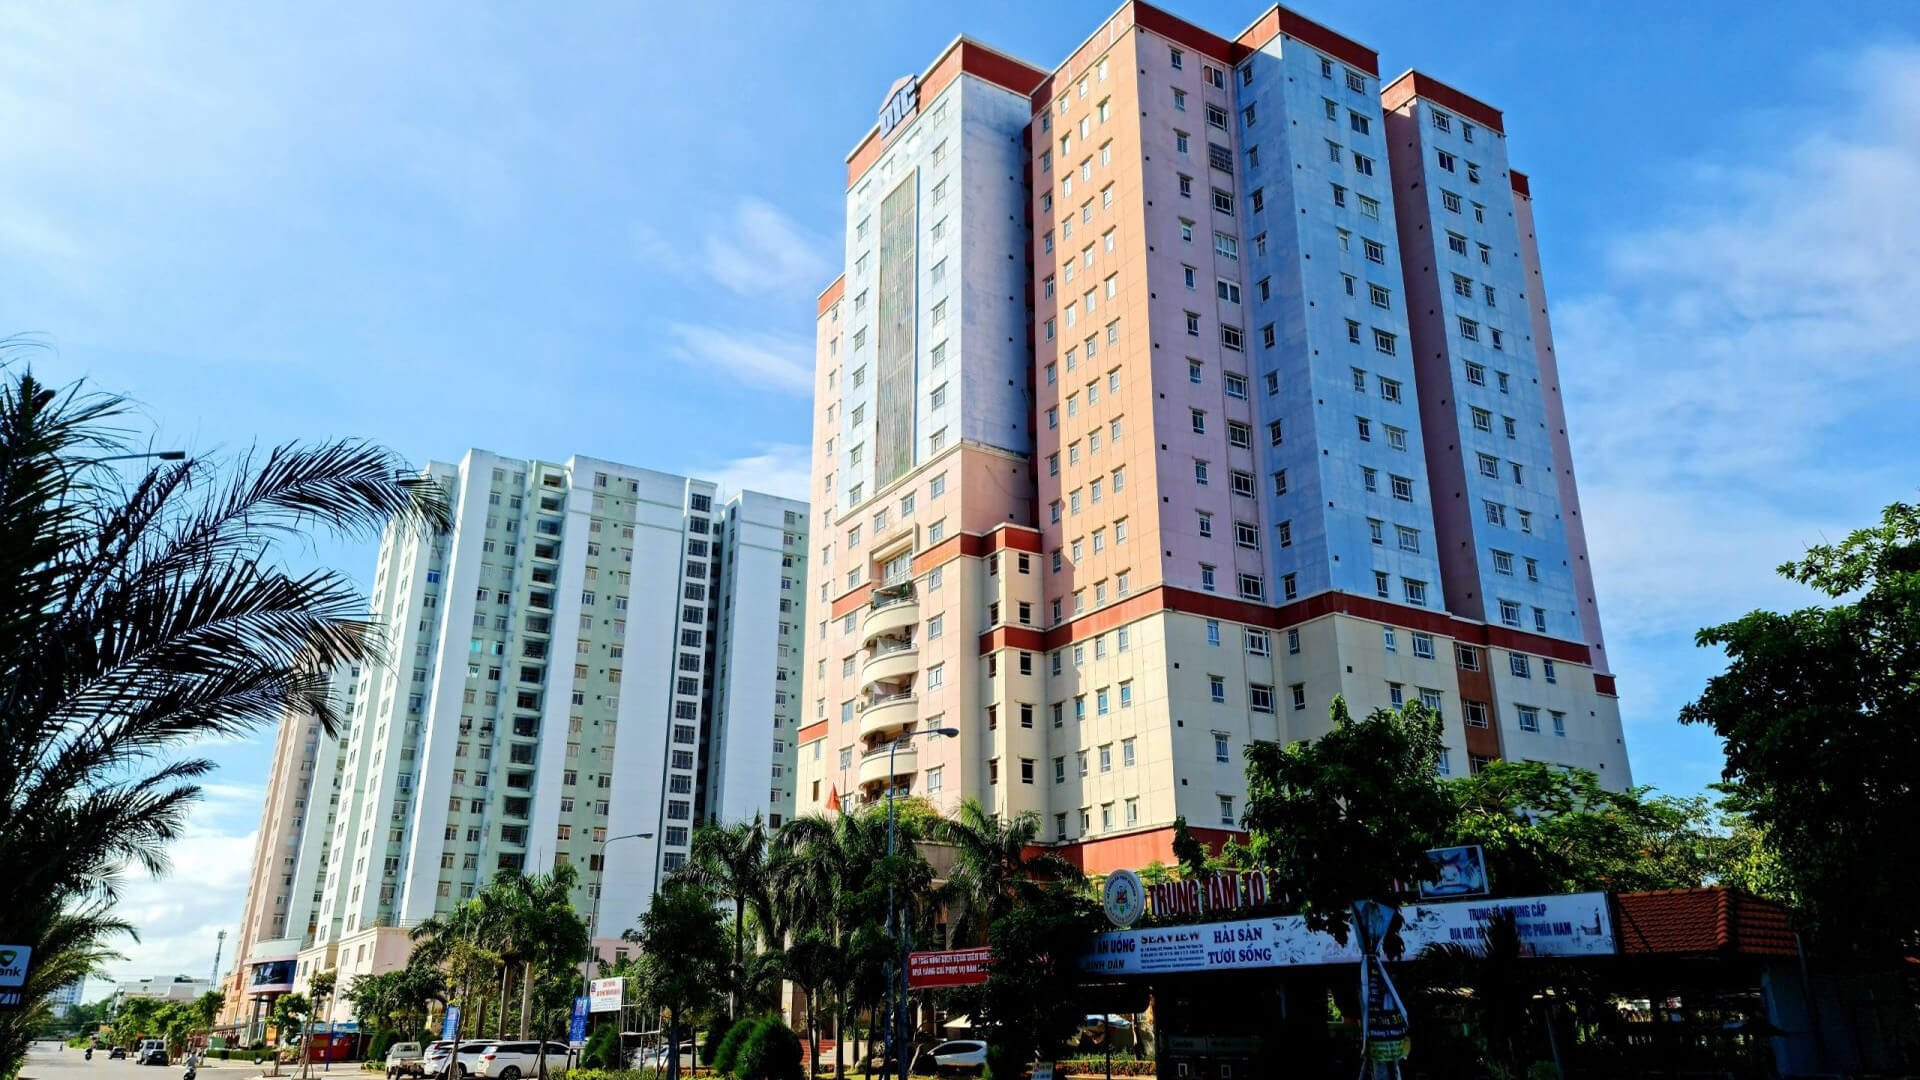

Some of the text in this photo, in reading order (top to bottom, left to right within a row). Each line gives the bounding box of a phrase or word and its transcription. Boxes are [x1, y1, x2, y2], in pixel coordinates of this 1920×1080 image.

[879, 76, 917, 139] DIC
[1148, 879, 1200, 916] TRUNG
[1202, 870, 1241, 909] TÂM
[1468, 907, 1490, 921] TRUNG
[1531, 900, 1546, 917] CẤP
[1213, 923, 1262, 944] HẢI SẢN
[1533, 921, 1552, 937] PHÍA
[1553, 921, 1572, 936] NAM
[1110, 933, 1136, 953] UỐNG
[1208, 947, 1236, 964] TƯƠI
[1238, 943, 1272, 963] SỐNG
